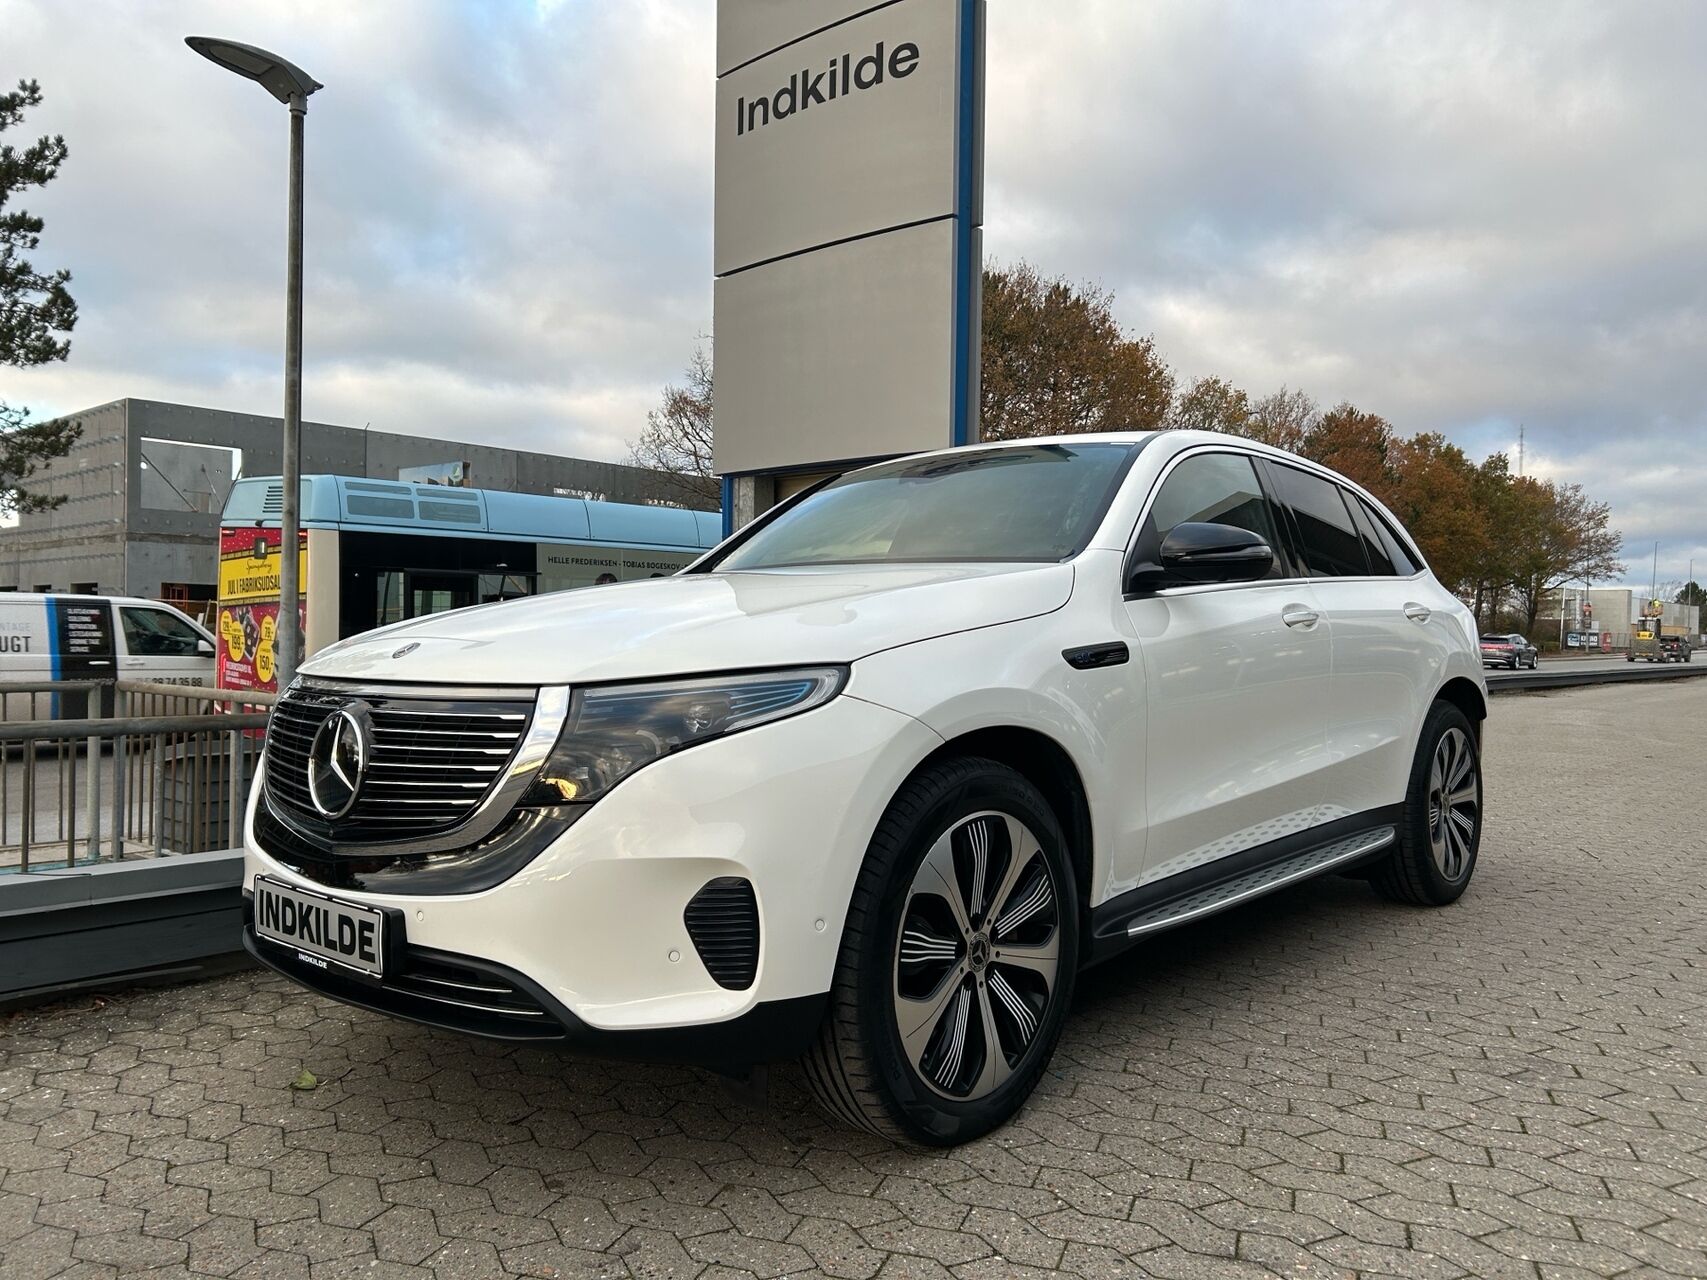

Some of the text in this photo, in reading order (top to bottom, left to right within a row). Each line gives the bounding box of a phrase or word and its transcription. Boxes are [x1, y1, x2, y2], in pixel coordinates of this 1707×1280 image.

[737, 41, 920, 136] Indkilde
[548, 556, 569, 565] HELLE
[571, 557, 617, 567] FREDERIKSEN
[623, 560, 645, 569] TOBIAS
[239, 574, 281, 594] FABRIKSUDSAL
[0, 635, 31, 653] UGT
[259, 888, 376, 964] INDKILDE
[298, 953, 328, 969] INDKILDE
